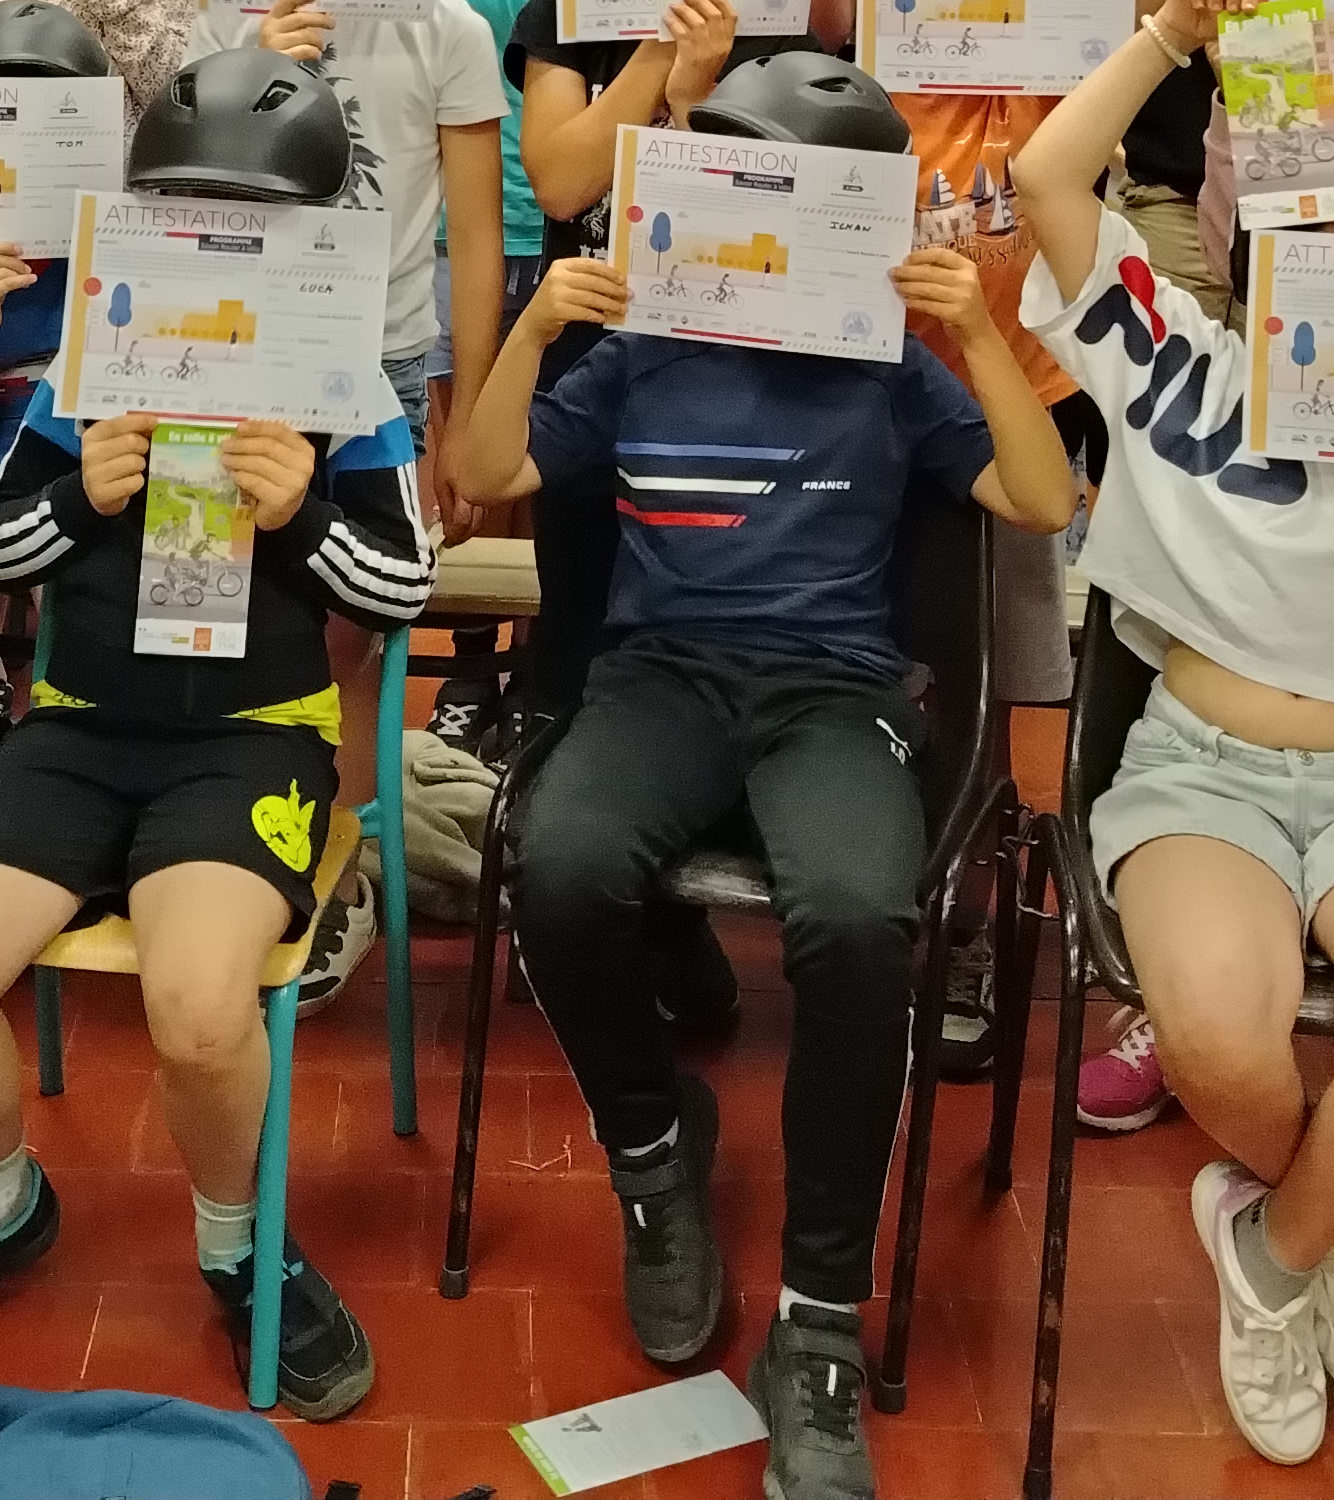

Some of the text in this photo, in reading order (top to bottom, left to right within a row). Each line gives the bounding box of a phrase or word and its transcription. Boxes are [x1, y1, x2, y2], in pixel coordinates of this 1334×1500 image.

[56, 140, 84, 148] TOM
[645, 139, 798, 173] ATTESTATION
[104, 204, 267, 233] ATTESTATION
[801, 480, 852, 491] FRANCE
